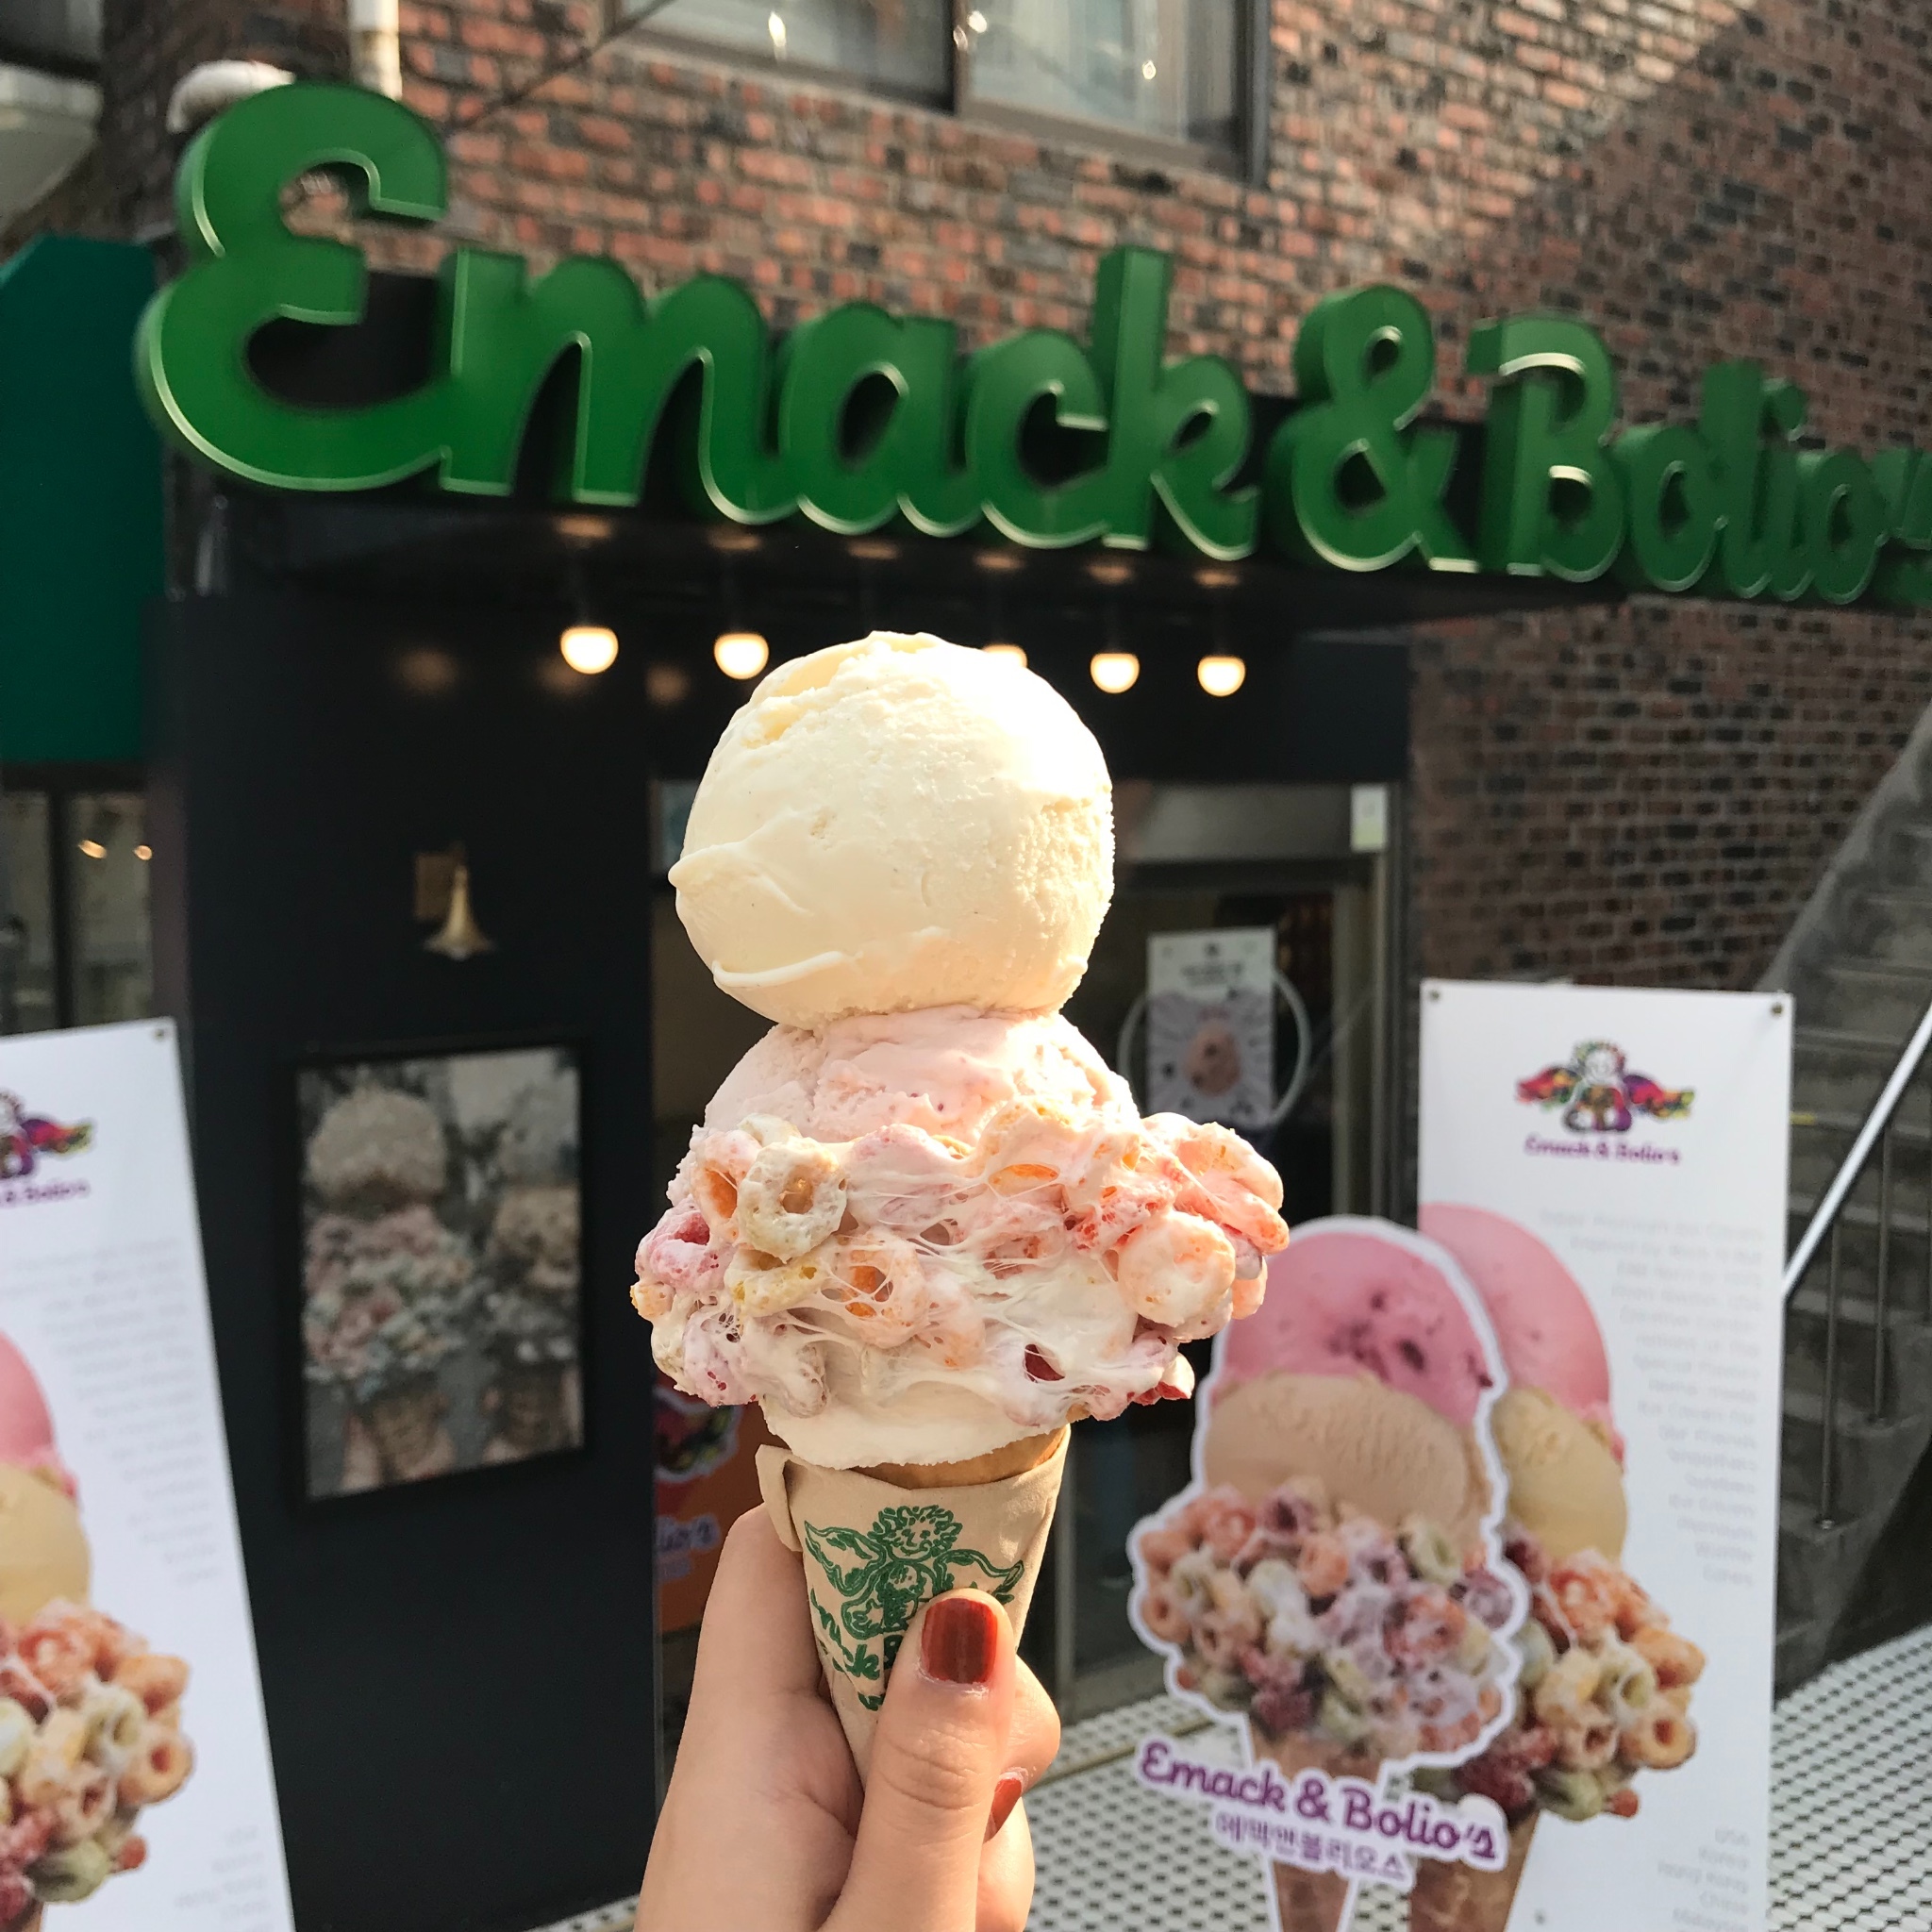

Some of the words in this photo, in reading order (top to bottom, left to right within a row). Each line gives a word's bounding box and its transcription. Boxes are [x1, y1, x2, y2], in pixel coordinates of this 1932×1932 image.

[136, 83, 1261, 561] Emack
[1270, 282, 1479, 573] &
[1141, 1740, 1287, 1812] Emack
[1295, 1775, 1331, 1824] &
[1341, 1786, 1496, 1859] Bolio's
